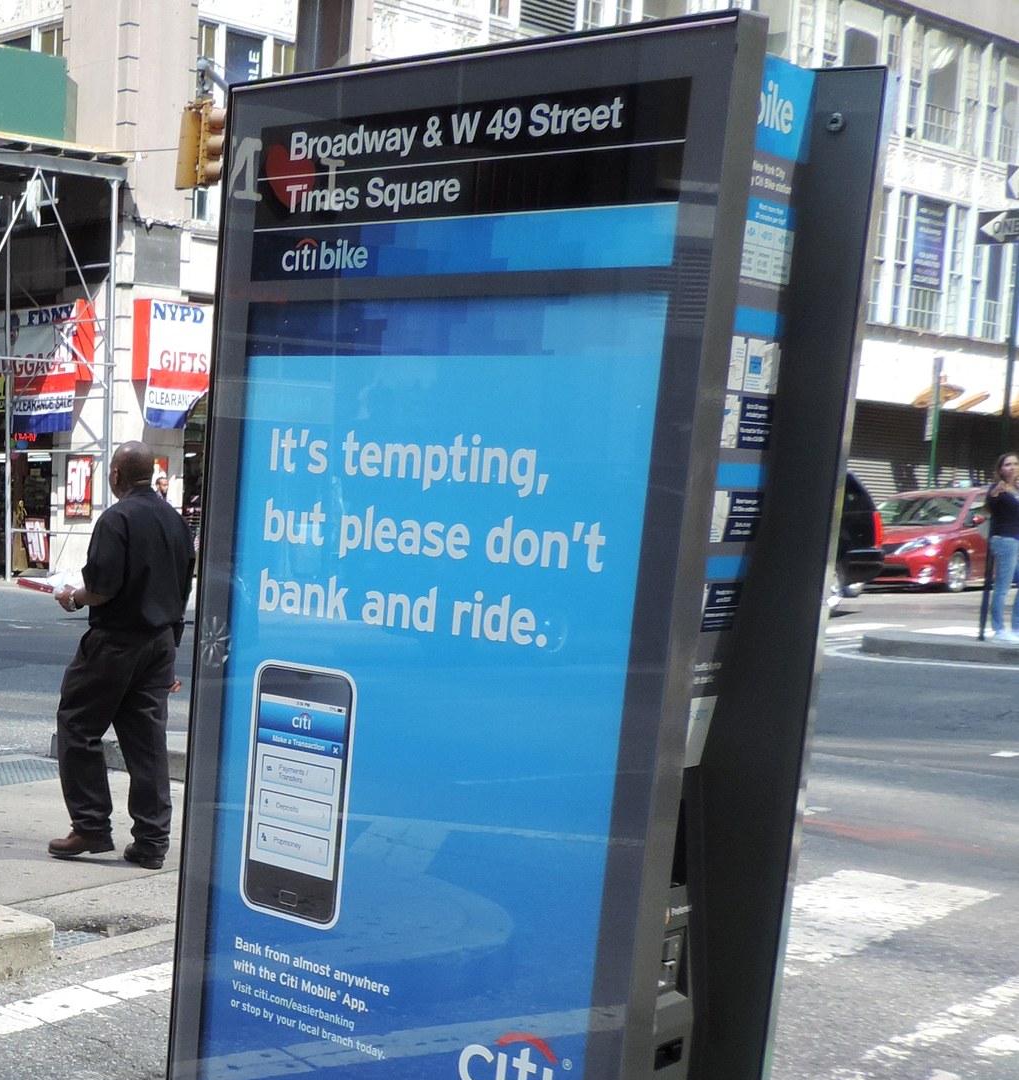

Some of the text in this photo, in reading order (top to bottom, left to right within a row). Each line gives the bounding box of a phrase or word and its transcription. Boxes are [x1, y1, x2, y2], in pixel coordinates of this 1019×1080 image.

[289, 97, 623, 161] Broadway & W 49 Street
[286, 173, 461, 213] Times Square
[319, 239, 368, 270] bike
[28, 304, 76, 327] FDNY
[153, 303, 205, 323] NYPD
[160, 350, 208, 373] GIFTS
[148, 391, 193, 407] CLEARAN
[269, 427, 550, 498] It's tempting,
[263, 497, 607, 573] but please don't
[258, 567, 548, 648] bank and ride.
[291, 712, 312, 731] citi
[272, 734, 287, 744] Make
[293, 738, 326, 752] Transaction
[278, 764, 305, 776] Payments
[278, 772, 303, 784] Transfers
[275, 802, 299, 814] Deposits
[234, 936, 390, 996] Bank from almost anywhere
[233, 959, 256, 976] with
[258, 965, 277, 983] the
[279, 972, 298, 990] Citi
[342, 993, 369, 1013] App.
[232, 980, 355, 1032] Visit citi.com/easierbanking
[230, 999, 386, 1061] or stop by your local branch today.
